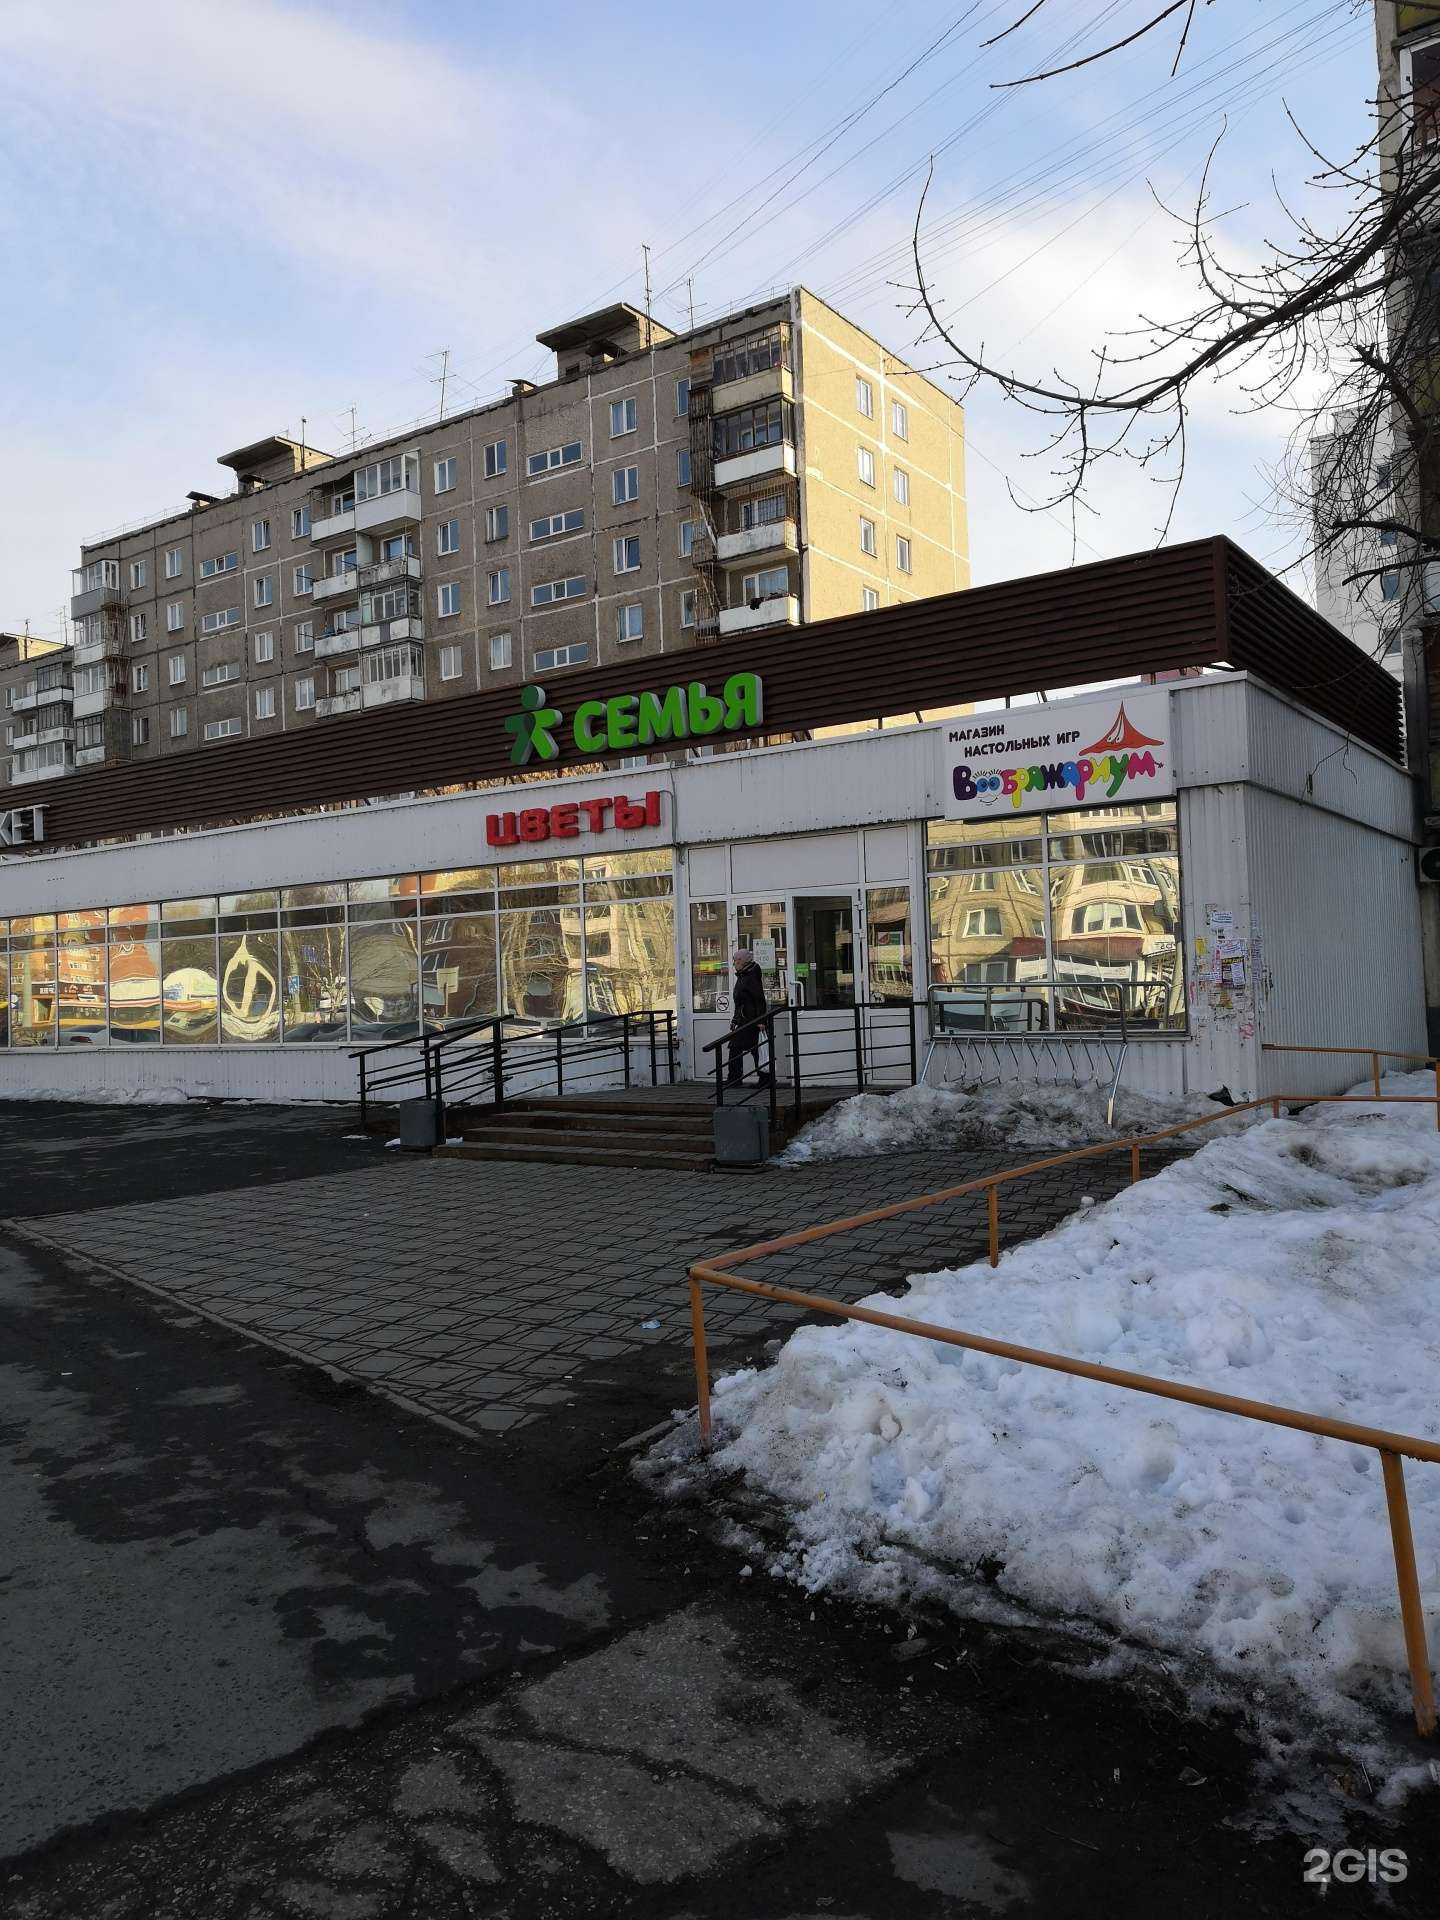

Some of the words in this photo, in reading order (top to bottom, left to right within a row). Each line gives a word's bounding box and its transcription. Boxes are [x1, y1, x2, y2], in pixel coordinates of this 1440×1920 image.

[574, 672, 763, 752] СЕМЬЯ
[948, 724, 1005, 743] МАГАЗИН
[964, 734, 1051, 758] НАСТОЛЬНЫХ
[1056, 730, 1081, 745] ИГР
[485, 790, 661, 847] ЦВЕТЫ
